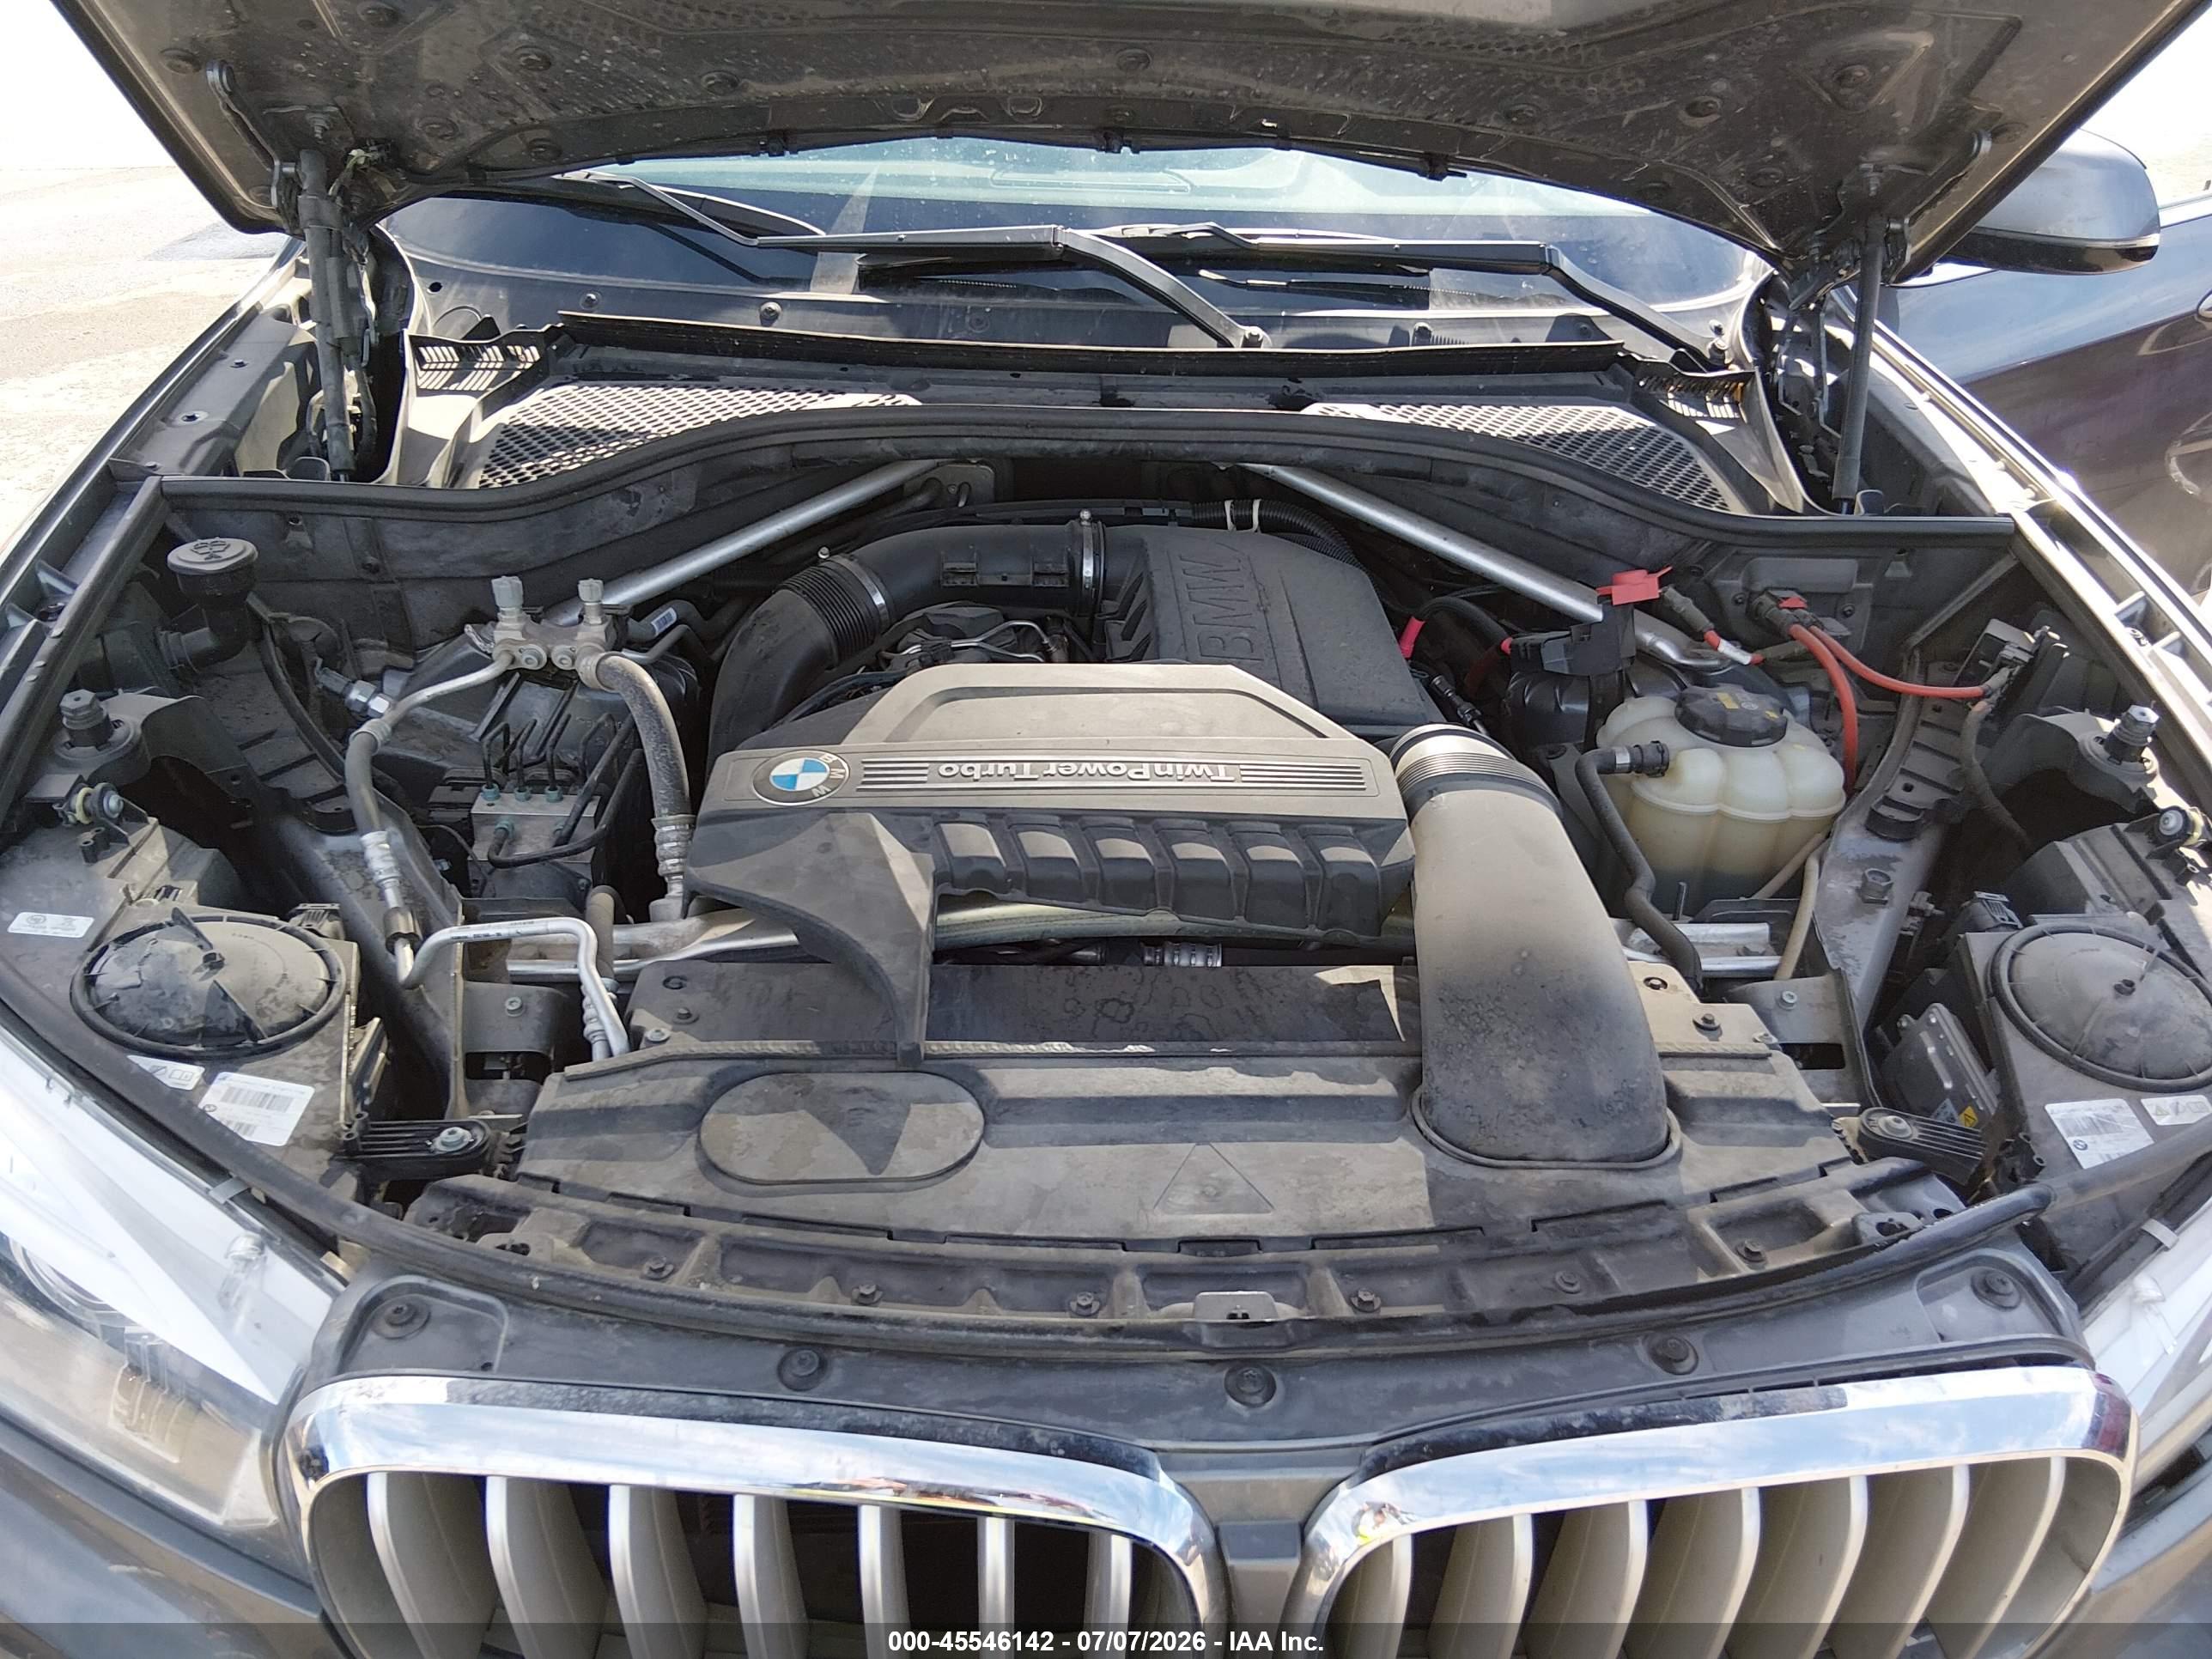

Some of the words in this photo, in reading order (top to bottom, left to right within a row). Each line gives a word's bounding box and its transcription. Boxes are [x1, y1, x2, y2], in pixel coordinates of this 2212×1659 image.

[1179, 554, 1265, 661] BMW
[811, 753, 846, 797] BMW
[938, 762, 1039, 781] Turbo
